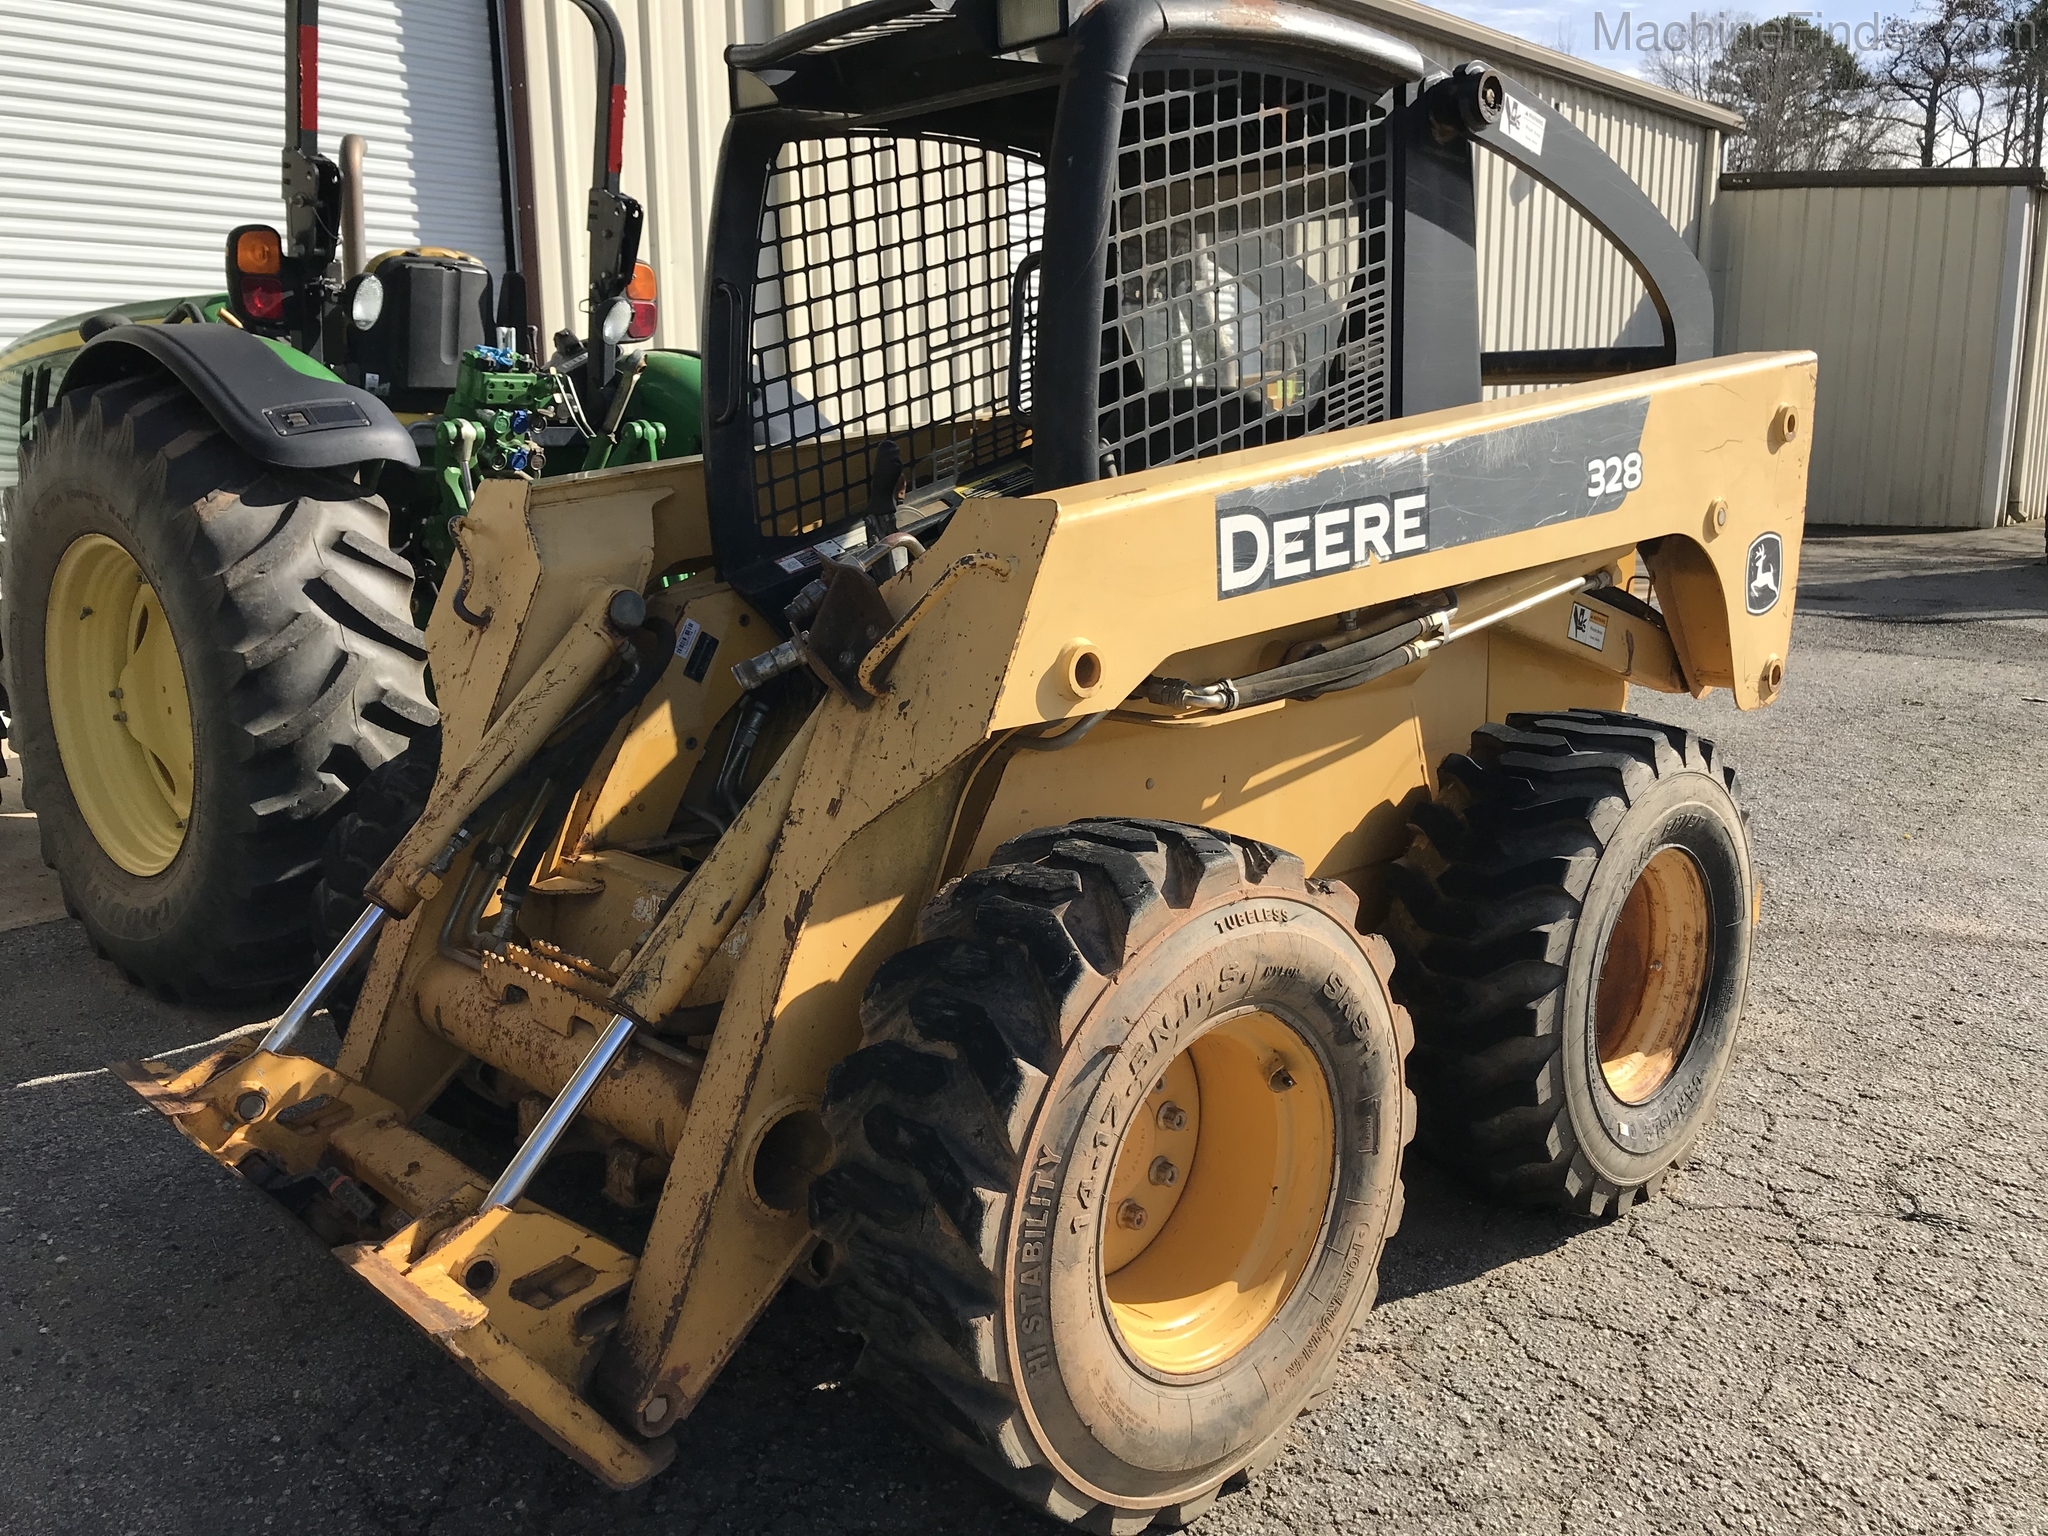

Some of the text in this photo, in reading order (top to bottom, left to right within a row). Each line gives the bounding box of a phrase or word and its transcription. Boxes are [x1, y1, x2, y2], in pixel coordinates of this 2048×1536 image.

[1587, 452, 1642, 498] 328
[1219, 493, 1428, 593] DEERE
[1213, 907, 1289, 935] TUBELESS
[1020, 1142, 1062, 1380] HI STABILITY
